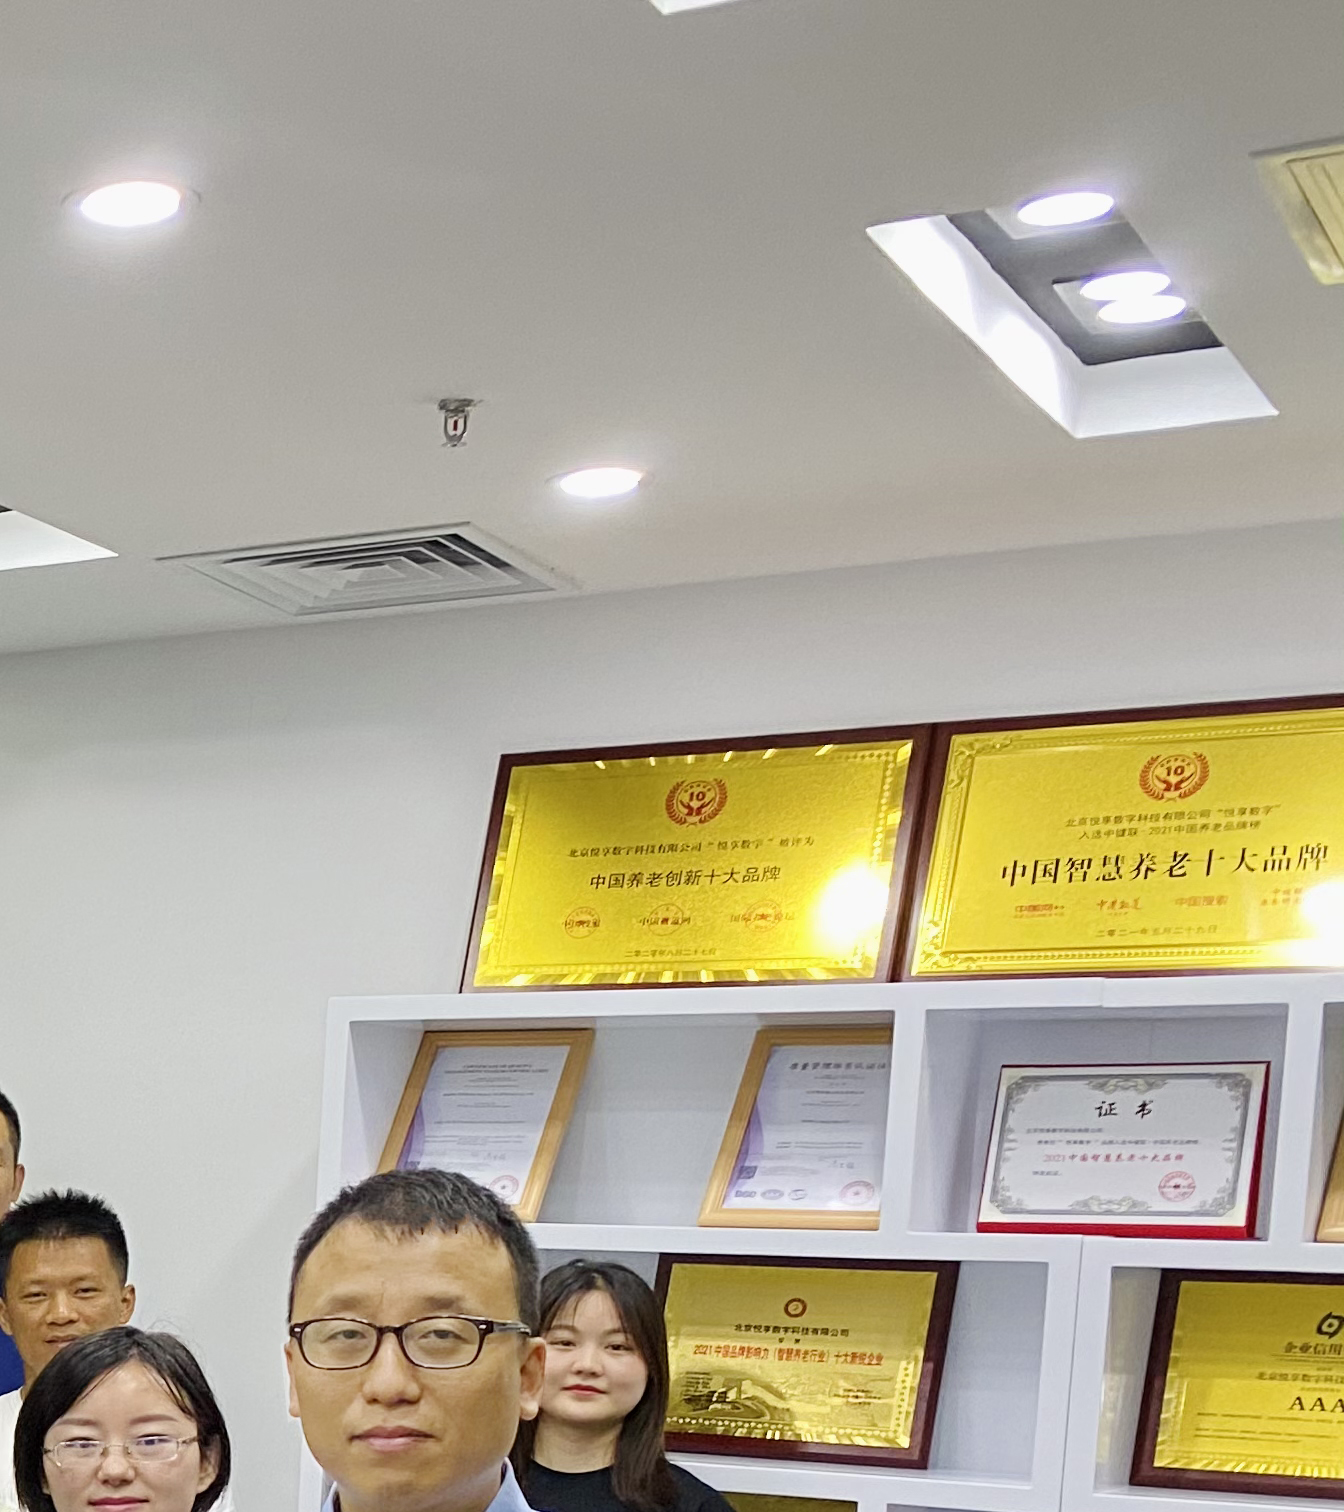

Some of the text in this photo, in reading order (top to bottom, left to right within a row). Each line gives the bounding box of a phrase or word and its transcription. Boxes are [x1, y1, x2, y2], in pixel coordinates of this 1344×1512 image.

[1001, 842, 1330, 888] 中国智慧养老十大品牌
[590, 866, 781, 890] 中国养老创新十大品牌
[1094, 1100, 1153, 1119] 证书
